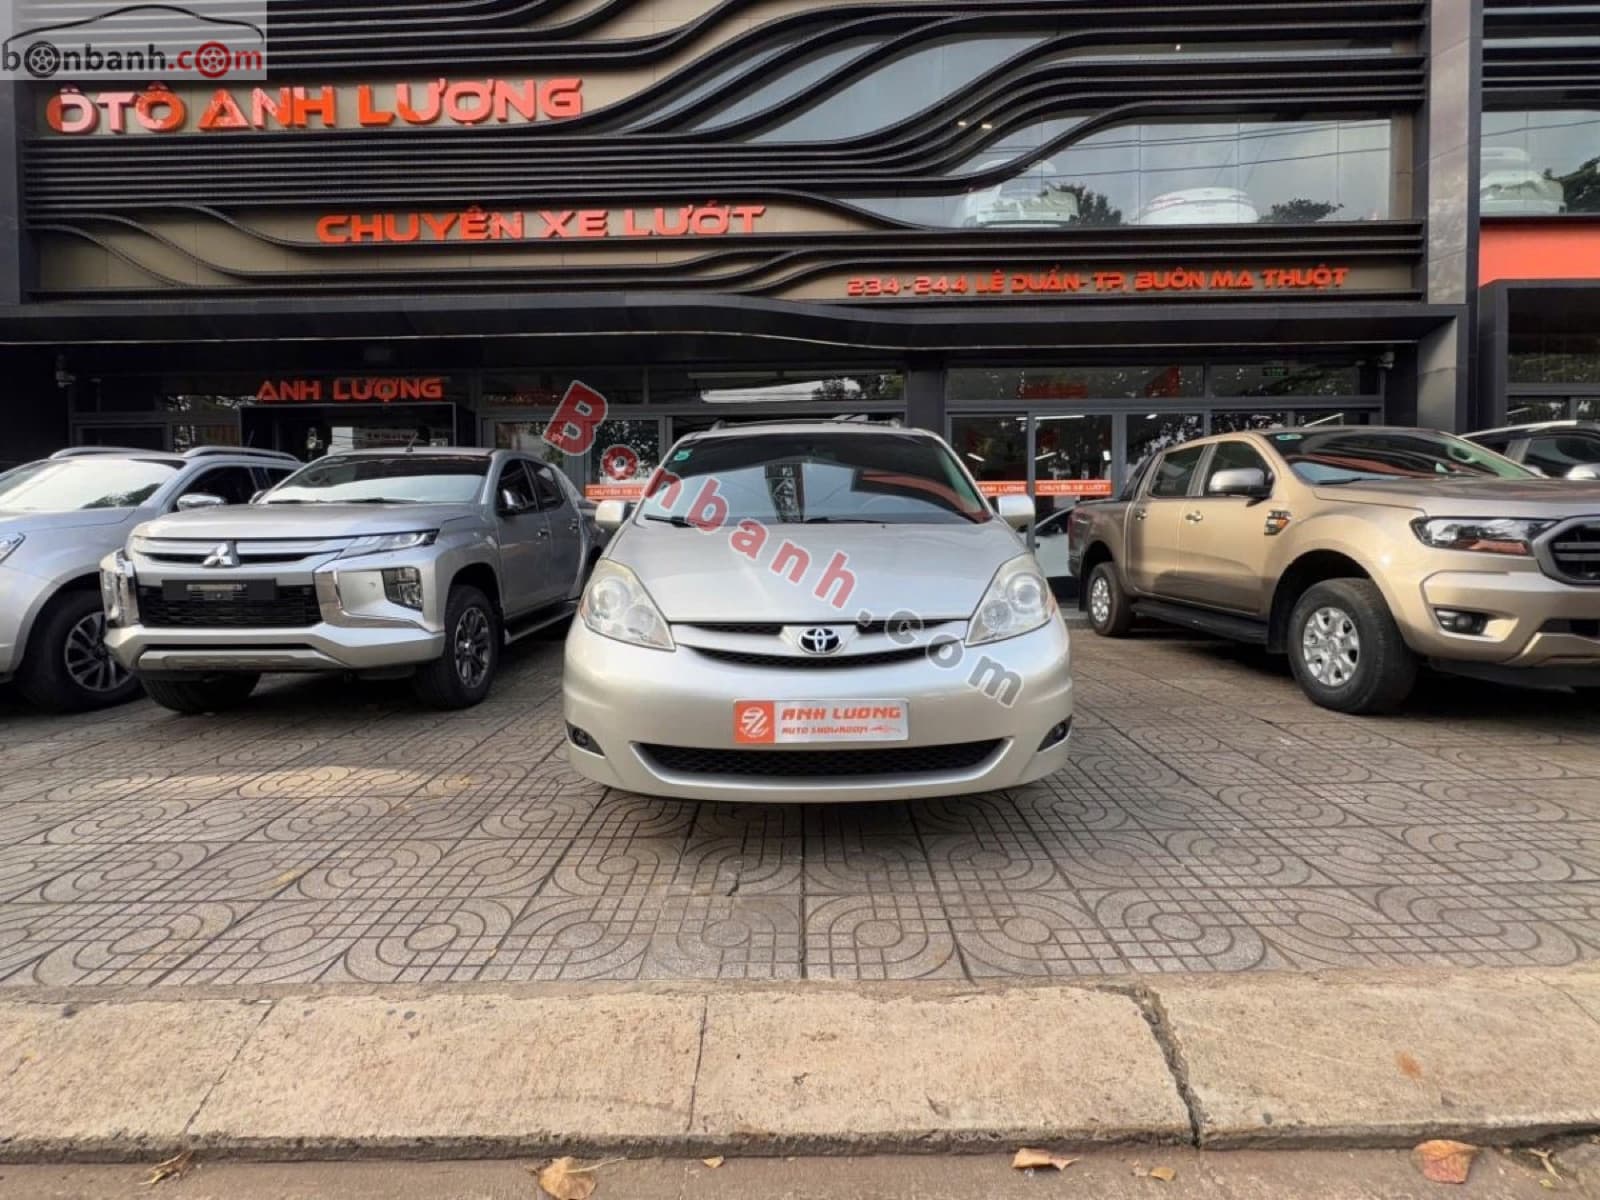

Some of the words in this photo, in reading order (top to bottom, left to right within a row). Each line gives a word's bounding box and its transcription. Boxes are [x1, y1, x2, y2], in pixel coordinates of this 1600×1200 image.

[197, 85, 337, 128] ANH
[316, 205, 524, 243] CHUYÊN
[543, 210, 609, 238] XE
[847, 276, 967, 296] 234-244
[974, 269, 1004, 293] LÊ
[1134, 267, 1205, 291] BUÔN
[1209, 270, 1255, 289] MA
[256, 380, 320, 401] ANH
[781, 707, 826, 721] ANH
[782, 725, 809, 735] AUTO
